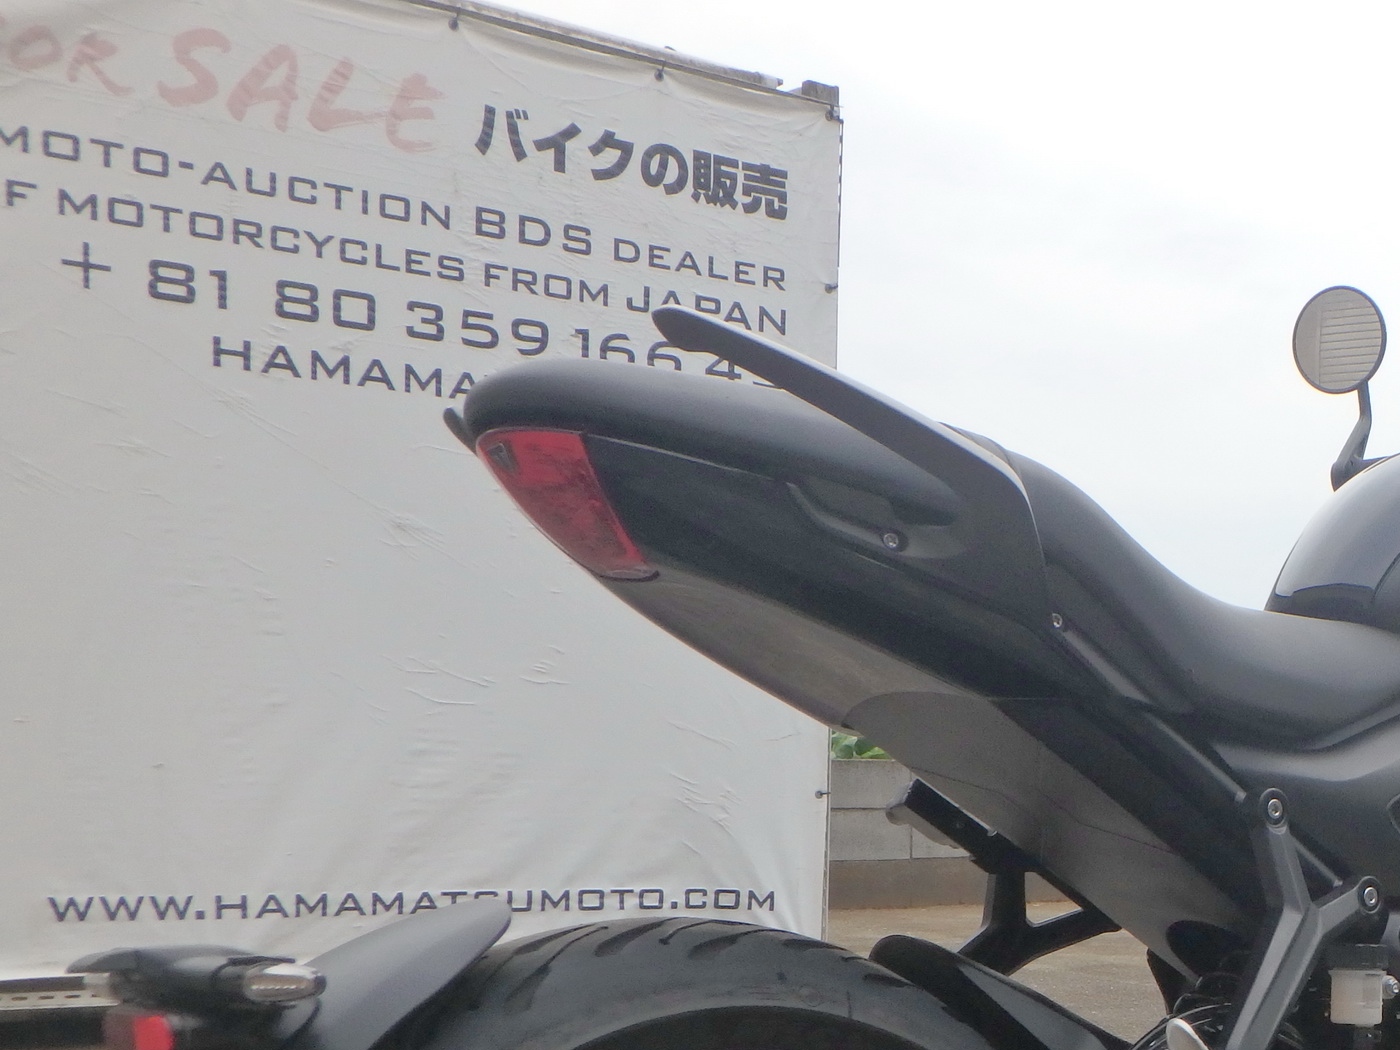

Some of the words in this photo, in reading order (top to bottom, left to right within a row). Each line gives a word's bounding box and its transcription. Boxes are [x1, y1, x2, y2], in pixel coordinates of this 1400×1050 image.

[0, 25, 134, 97] OR
[156, 27, 448, 153] SALE
[0, 126, 451, 230] MOTO-AUCTION
[475, 205, 592, 256] BDS
[613, 237, 786, 291] DEALER
[475, 104, 788, 221] バイクの販売
[58, 188, 465, 282] MOTORCYCLES
[484, 262, 609, 307] FROM
[148, 258, 228, 310] 81
[275, 279, 376, 331] 80
[406, 300, 549, 356] 359
